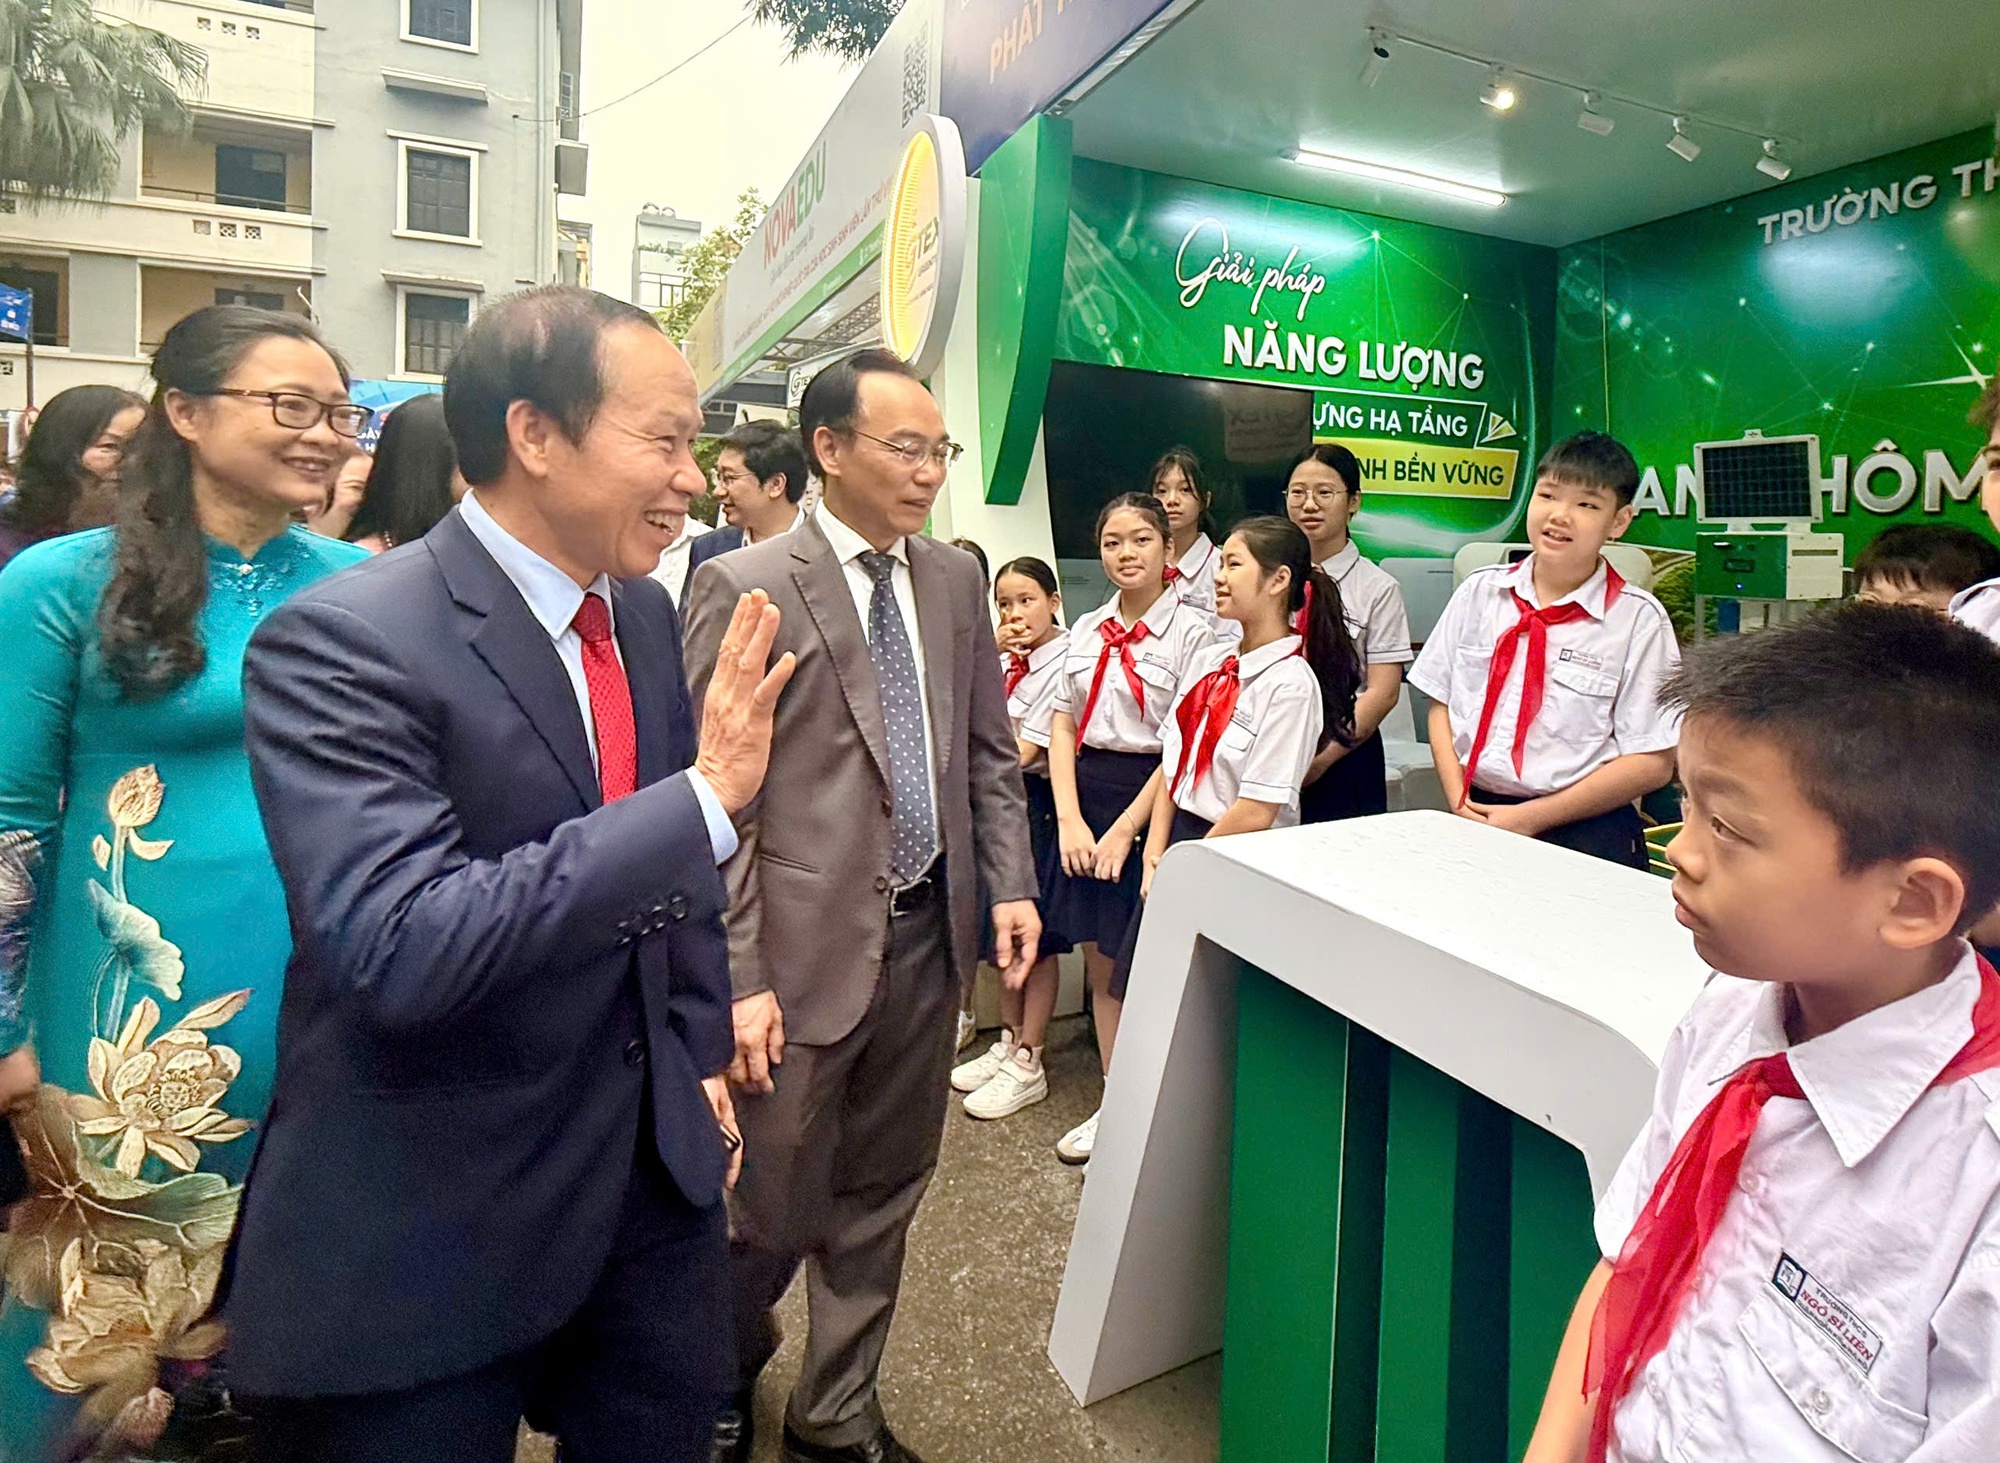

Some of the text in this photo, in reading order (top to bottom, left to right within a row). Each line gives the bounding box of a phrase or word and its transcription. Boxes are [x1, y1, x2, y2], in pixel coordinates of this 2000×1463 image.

[763, 139, 826, 270] NOVAEDU
[1757, 175, 1938, 244] TRƯỜNG
[1175, 216, 1326, 321] Giải pháp
[1223, 321, 1485, 391] NĂNG LƯỢNG
[1313, 402, 1364, 430] ỰNG
[1369, 408, 1402, 436] HẠ
[1408, 404, 1468, 437] TẦNG
[1358, 451, 1504, 486] NH BỀN VỮNG
[1800, 1289, 1828, 1317] NGÔ
[1842, 1327, 1874, 1361] LIÊN
